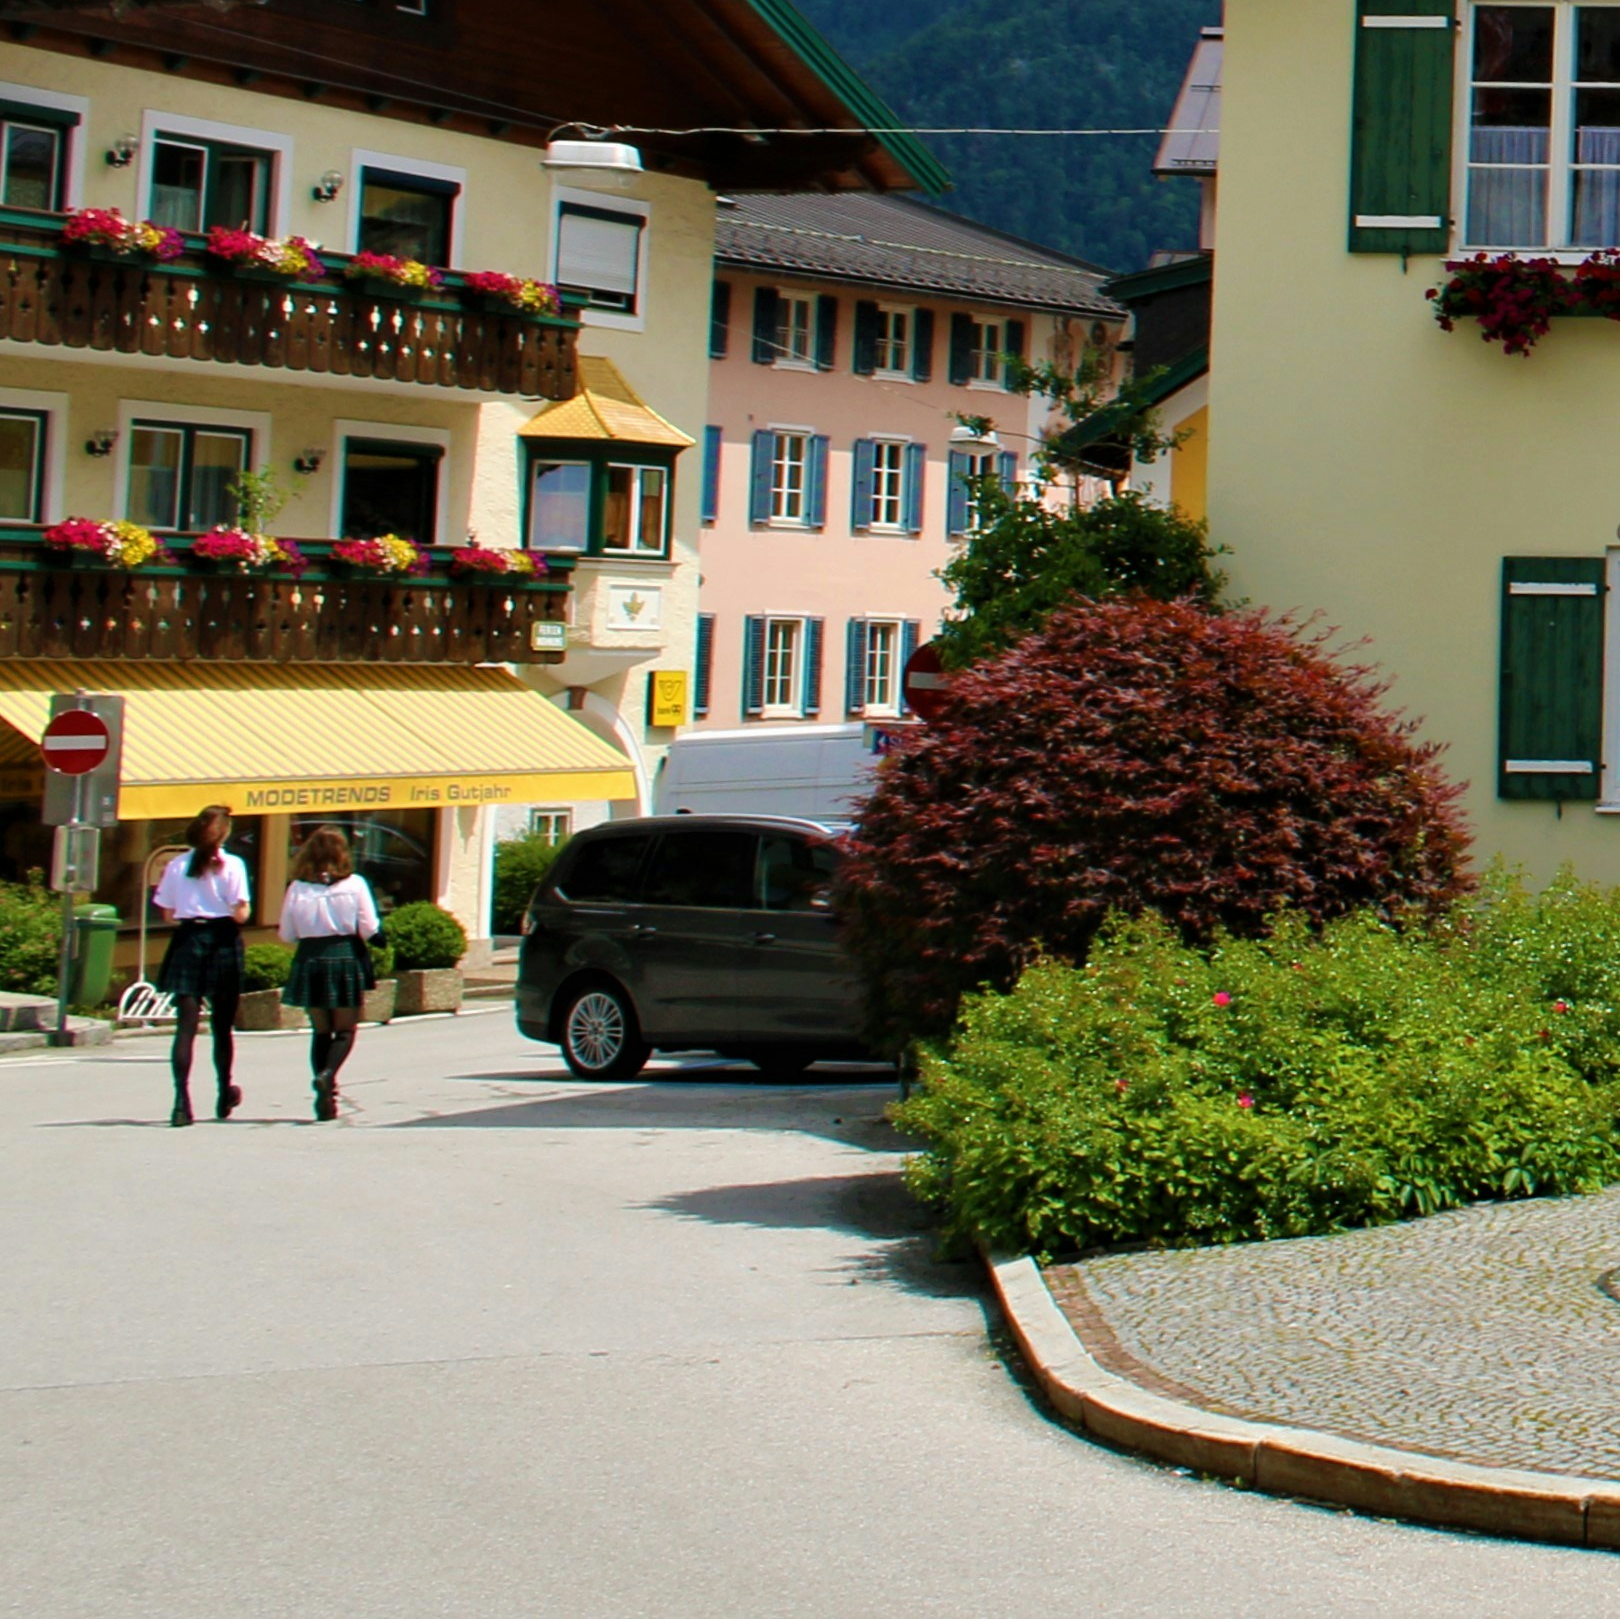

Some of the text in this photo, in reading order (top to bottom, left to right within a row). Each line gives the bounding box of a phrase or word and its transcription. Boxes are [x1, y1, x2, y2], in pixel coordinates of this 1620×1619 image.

[247, 784, 511, 807] MODETRENDS Iris Gutjahr
